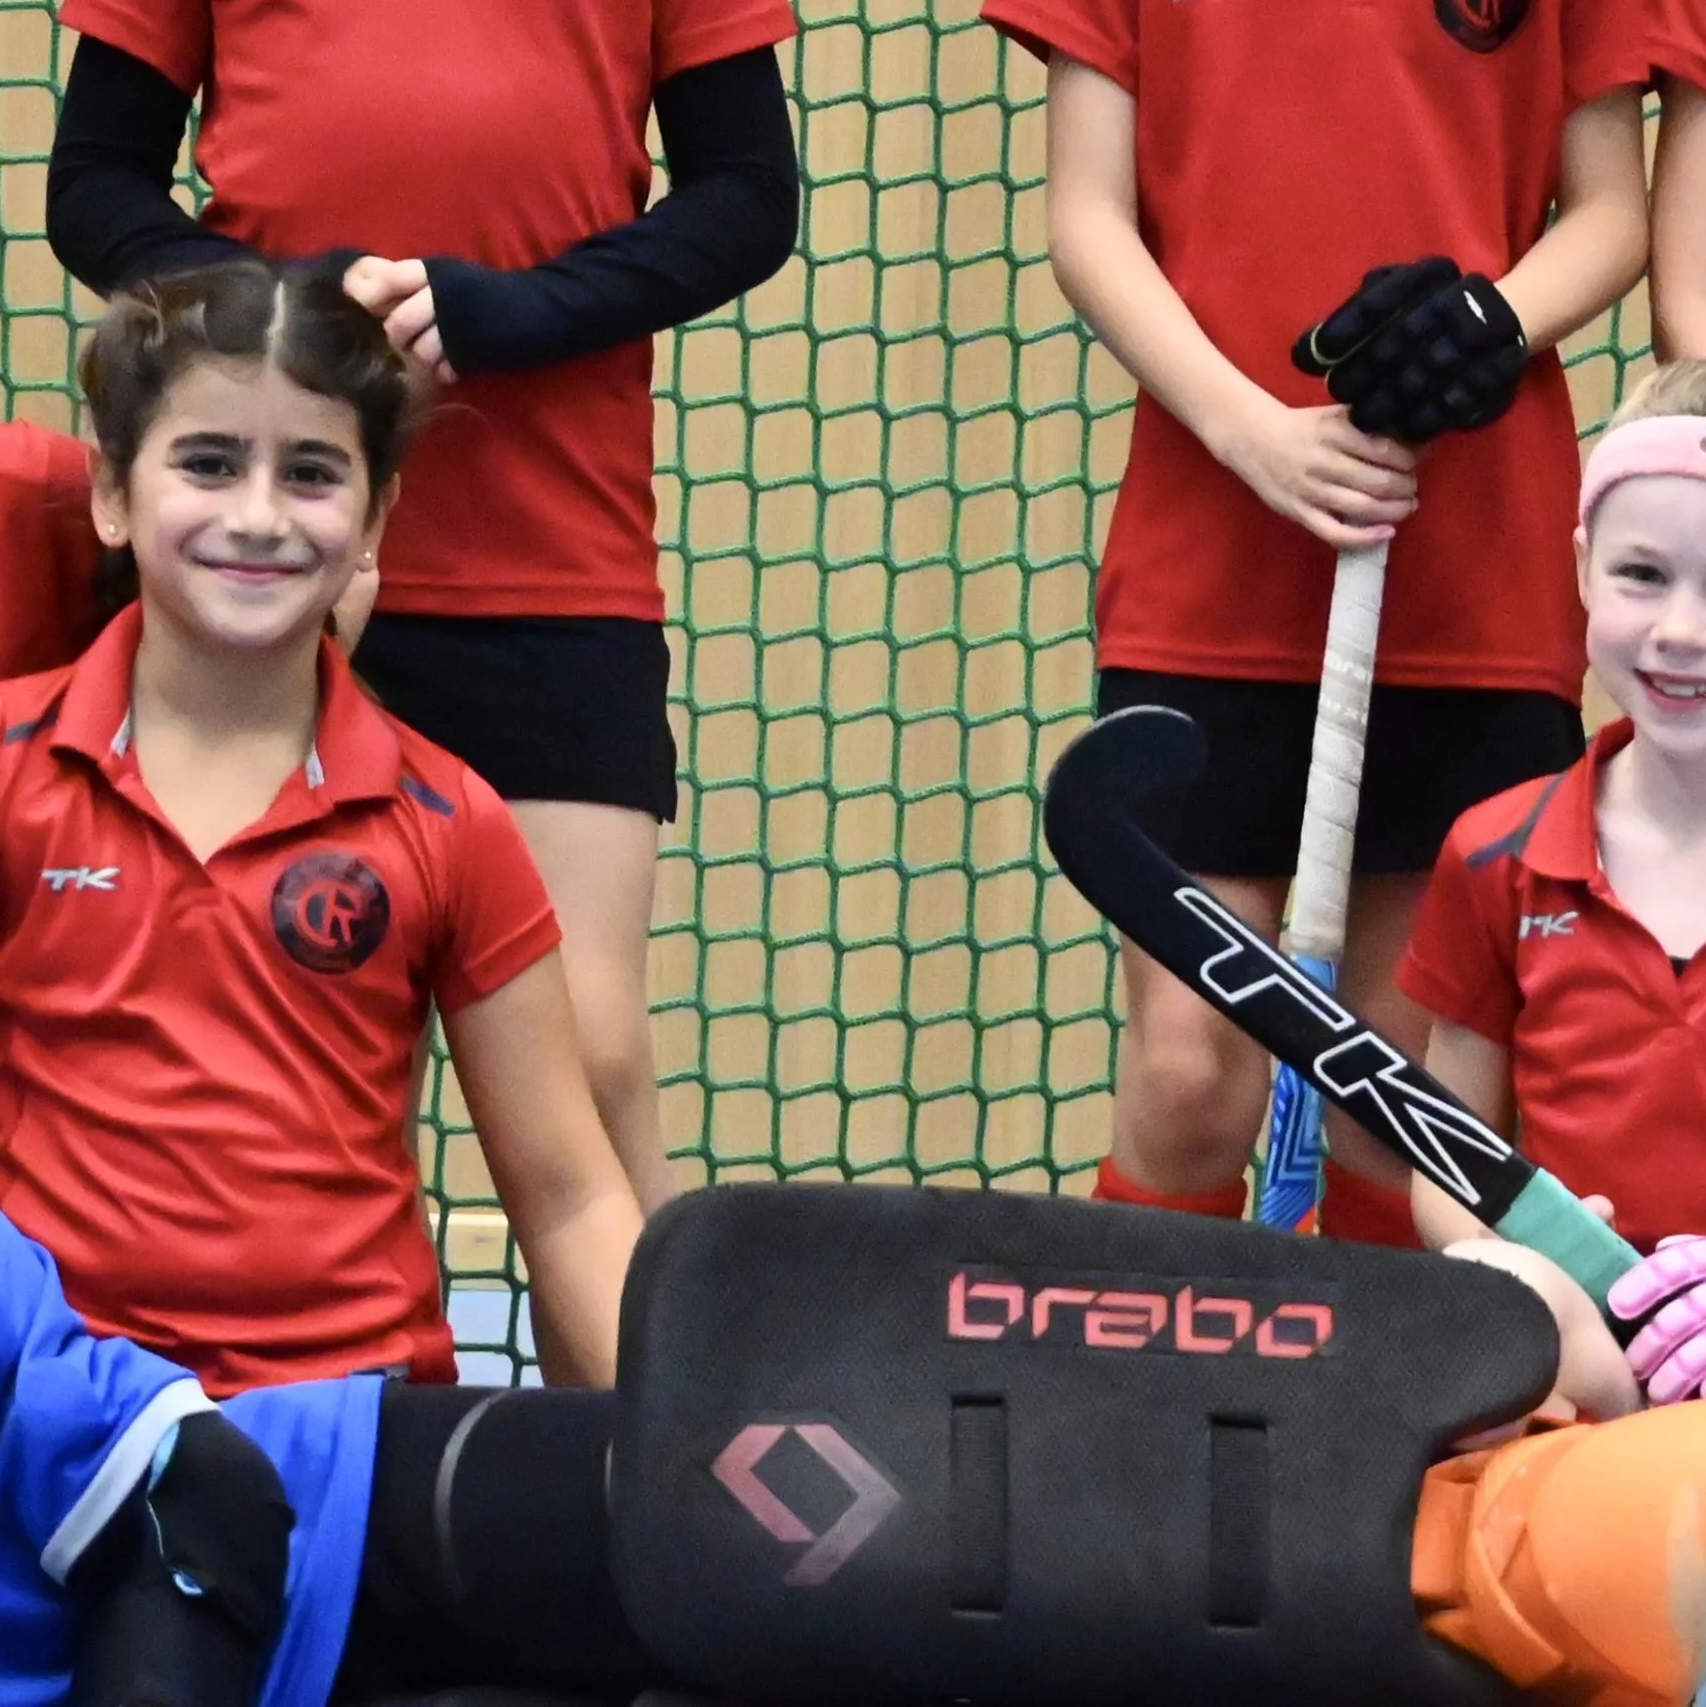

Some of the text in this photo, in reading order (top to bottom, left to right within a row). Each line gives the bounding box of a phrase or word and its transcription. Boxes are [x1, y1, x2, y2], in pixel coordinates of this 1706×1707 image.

[41, 866, 122, 891] TK
[1174, 886, 1514, 1206] TK
[947, 1271, 1336, 1359] brabo
